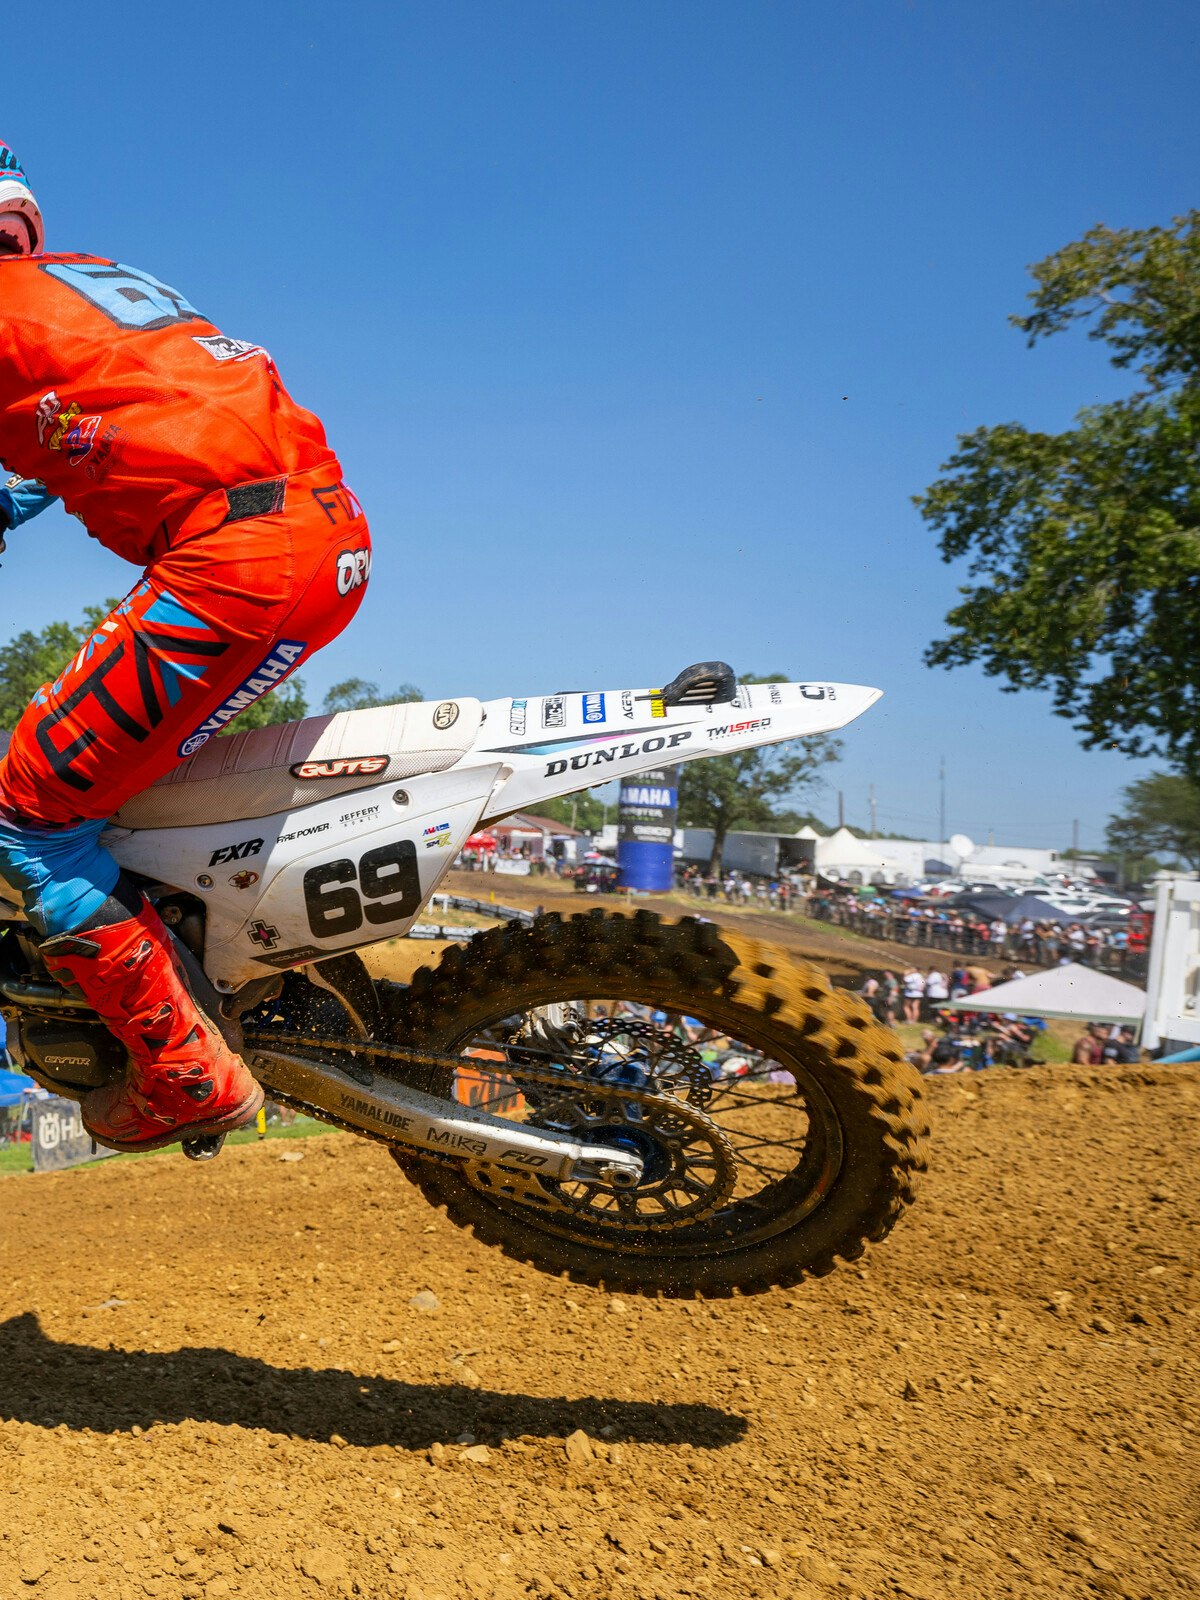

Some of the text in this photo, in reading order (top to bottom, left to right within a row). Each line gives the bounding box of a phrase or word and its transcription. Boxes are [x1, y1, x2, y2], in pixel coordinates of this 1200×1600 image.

[90, 424, 121, 465] YAMAHA
[199, 642, 303, 731] YAMAHA
[299, 756, 388, 778] GUTS
[544, 731, 692, 778] DUNLOP
[621, 787, 671, 806] AMAHA
[339, 805, 380, 822] JEFFERY
[297, 823, 330, 838] POWER
[208, 838, 265, 868] FXR
[303, 839, 422, 939] 69
[340, 1093, 413, 1131] YAMALUBE
[426, 1126, 488, 1153] Mika
